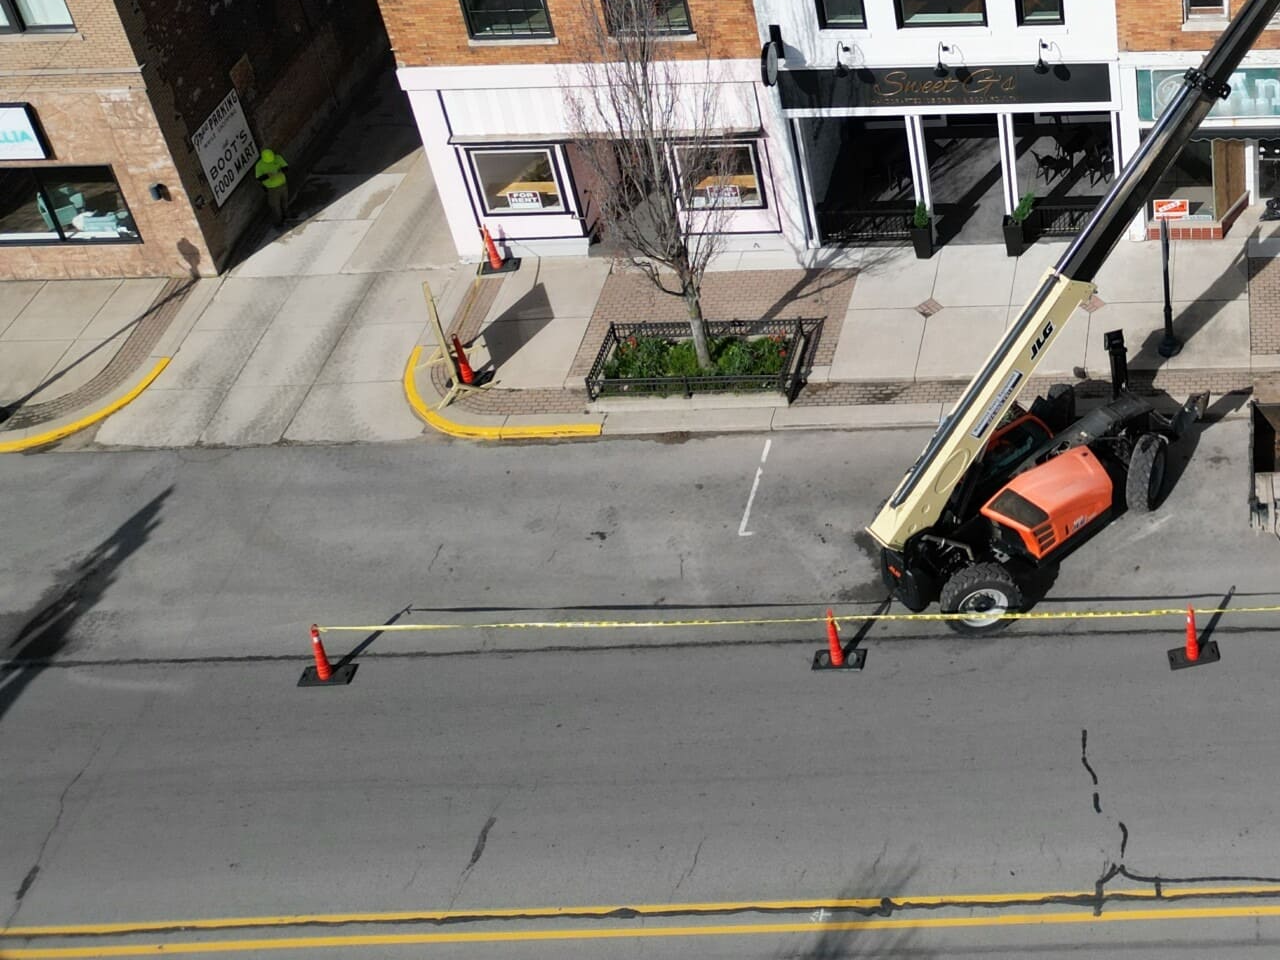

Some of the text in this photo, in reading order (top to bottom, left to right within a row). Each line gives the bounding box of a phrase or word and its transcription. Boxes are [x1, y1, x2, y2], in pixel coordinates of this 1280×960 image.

[873, 68, 1016, 97] Sweet G's
[207, 90, 239, 131] PARKING
[209, 129, 248, 181] BOOT'S
[214, 141, 256, 199] FOOD MART
[1031, 321, 1053, 360] JLG
